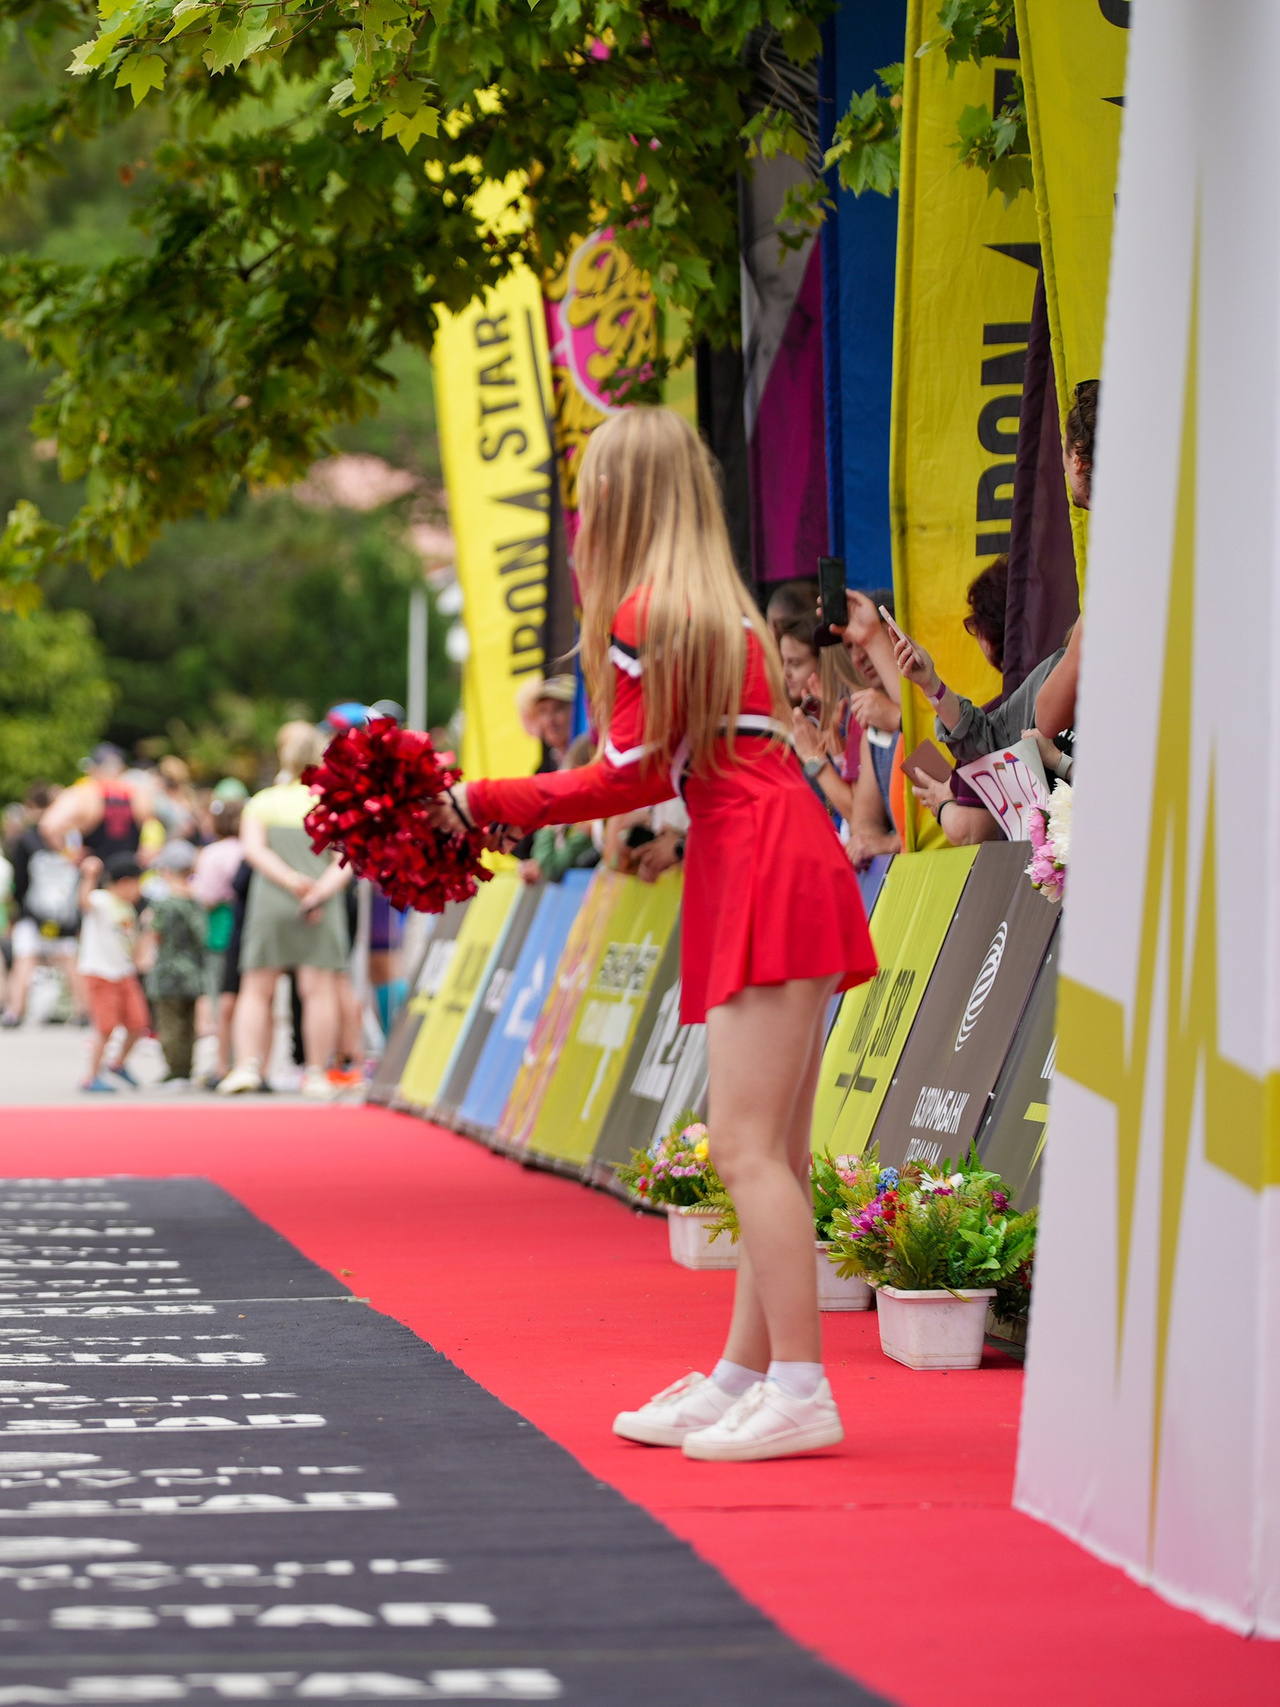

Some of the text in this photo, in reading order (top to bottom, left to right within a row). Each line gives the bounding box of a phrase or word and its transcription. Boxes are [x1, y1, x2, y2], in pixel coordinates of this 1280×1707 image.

[473, 310, 529, 463] STAR
[5, 1413, 326, 1430] STAR
[26, 1491, 398, 1514] STAR
[50, 1602, 496, 1630] STAR
[66, 1667, 562, 1700] STAR
